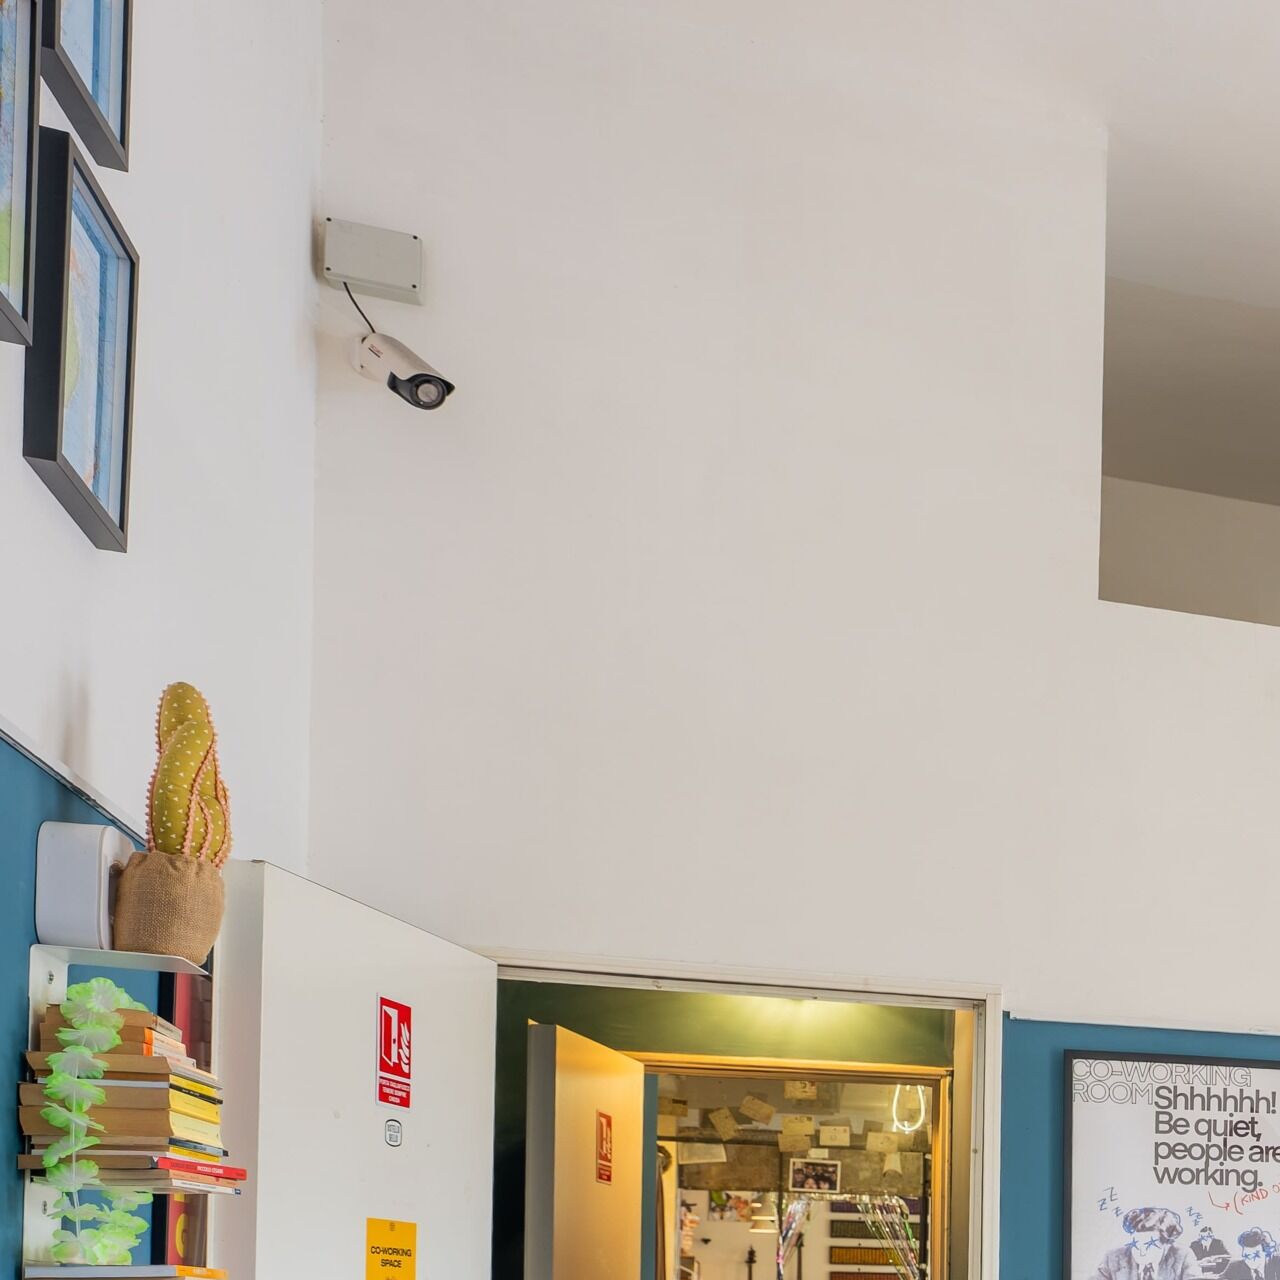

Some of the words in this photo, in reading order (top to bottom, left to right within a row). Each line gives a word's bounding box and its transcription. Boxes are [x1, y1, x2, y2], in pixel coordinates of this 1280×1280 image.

[1072, 1058, 1252, 1088] CO-WORKING
[1072, 1080, 1154, 1105] ROOM
[1154, 1111, 1191, 1136] Be
[1195, 1112, 1262, 1142] quiet,
[1153, 1136, 1245, 1165] people
[1152, 1161, 1264, 1194] working.
[370, 1245, 412, 1257] CO-WORKING
[380, 1258, 402, 1268] SPACE
